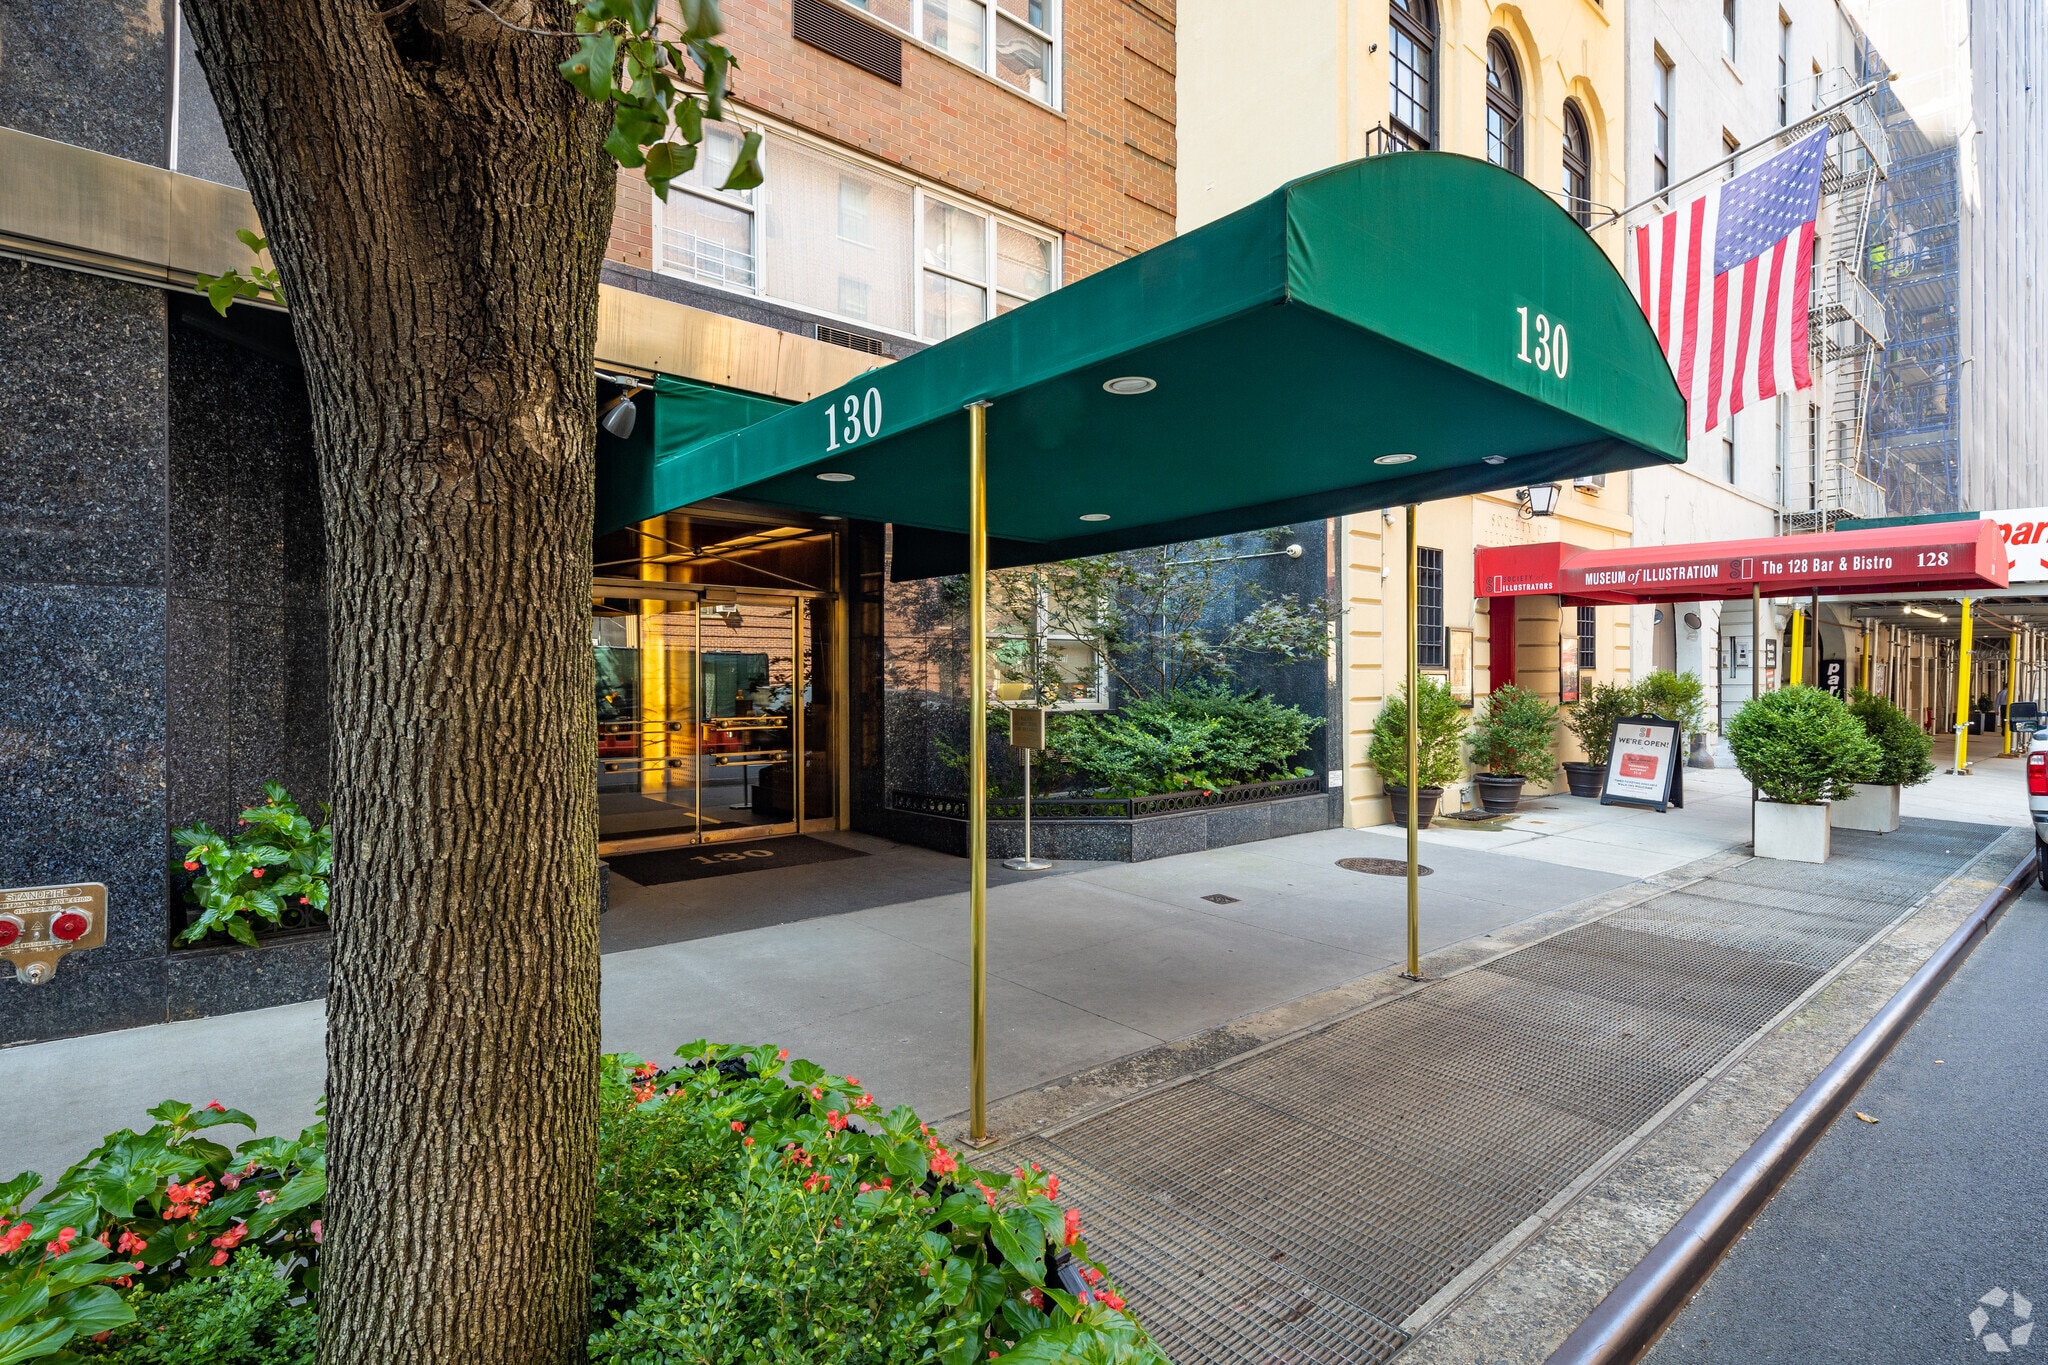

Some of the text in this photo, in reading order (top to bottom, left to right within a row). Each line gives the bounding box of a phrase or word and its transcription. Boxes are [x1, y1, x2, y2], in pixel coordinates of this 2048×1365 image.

[1517, 306, 1569, 379] 130
[824, 387, 882, 452] 130
[1761, 555, 1893, 575] The 128 Bar & Bistro
[1916, 551, 1949, 568] 128
[1503, 575, 1533, 583] SOCIETY
[1585, 564, 1719, 586] MUSEUM of ILLUSTRATION
[1502, 582, 1553, 592] ILLUSTRATORS
[1618, 737, 1669, 748] WE'RE OPEN!
[690, 849, 775, 865] 130
[6, 889, 68, 900] STANDPIPE
